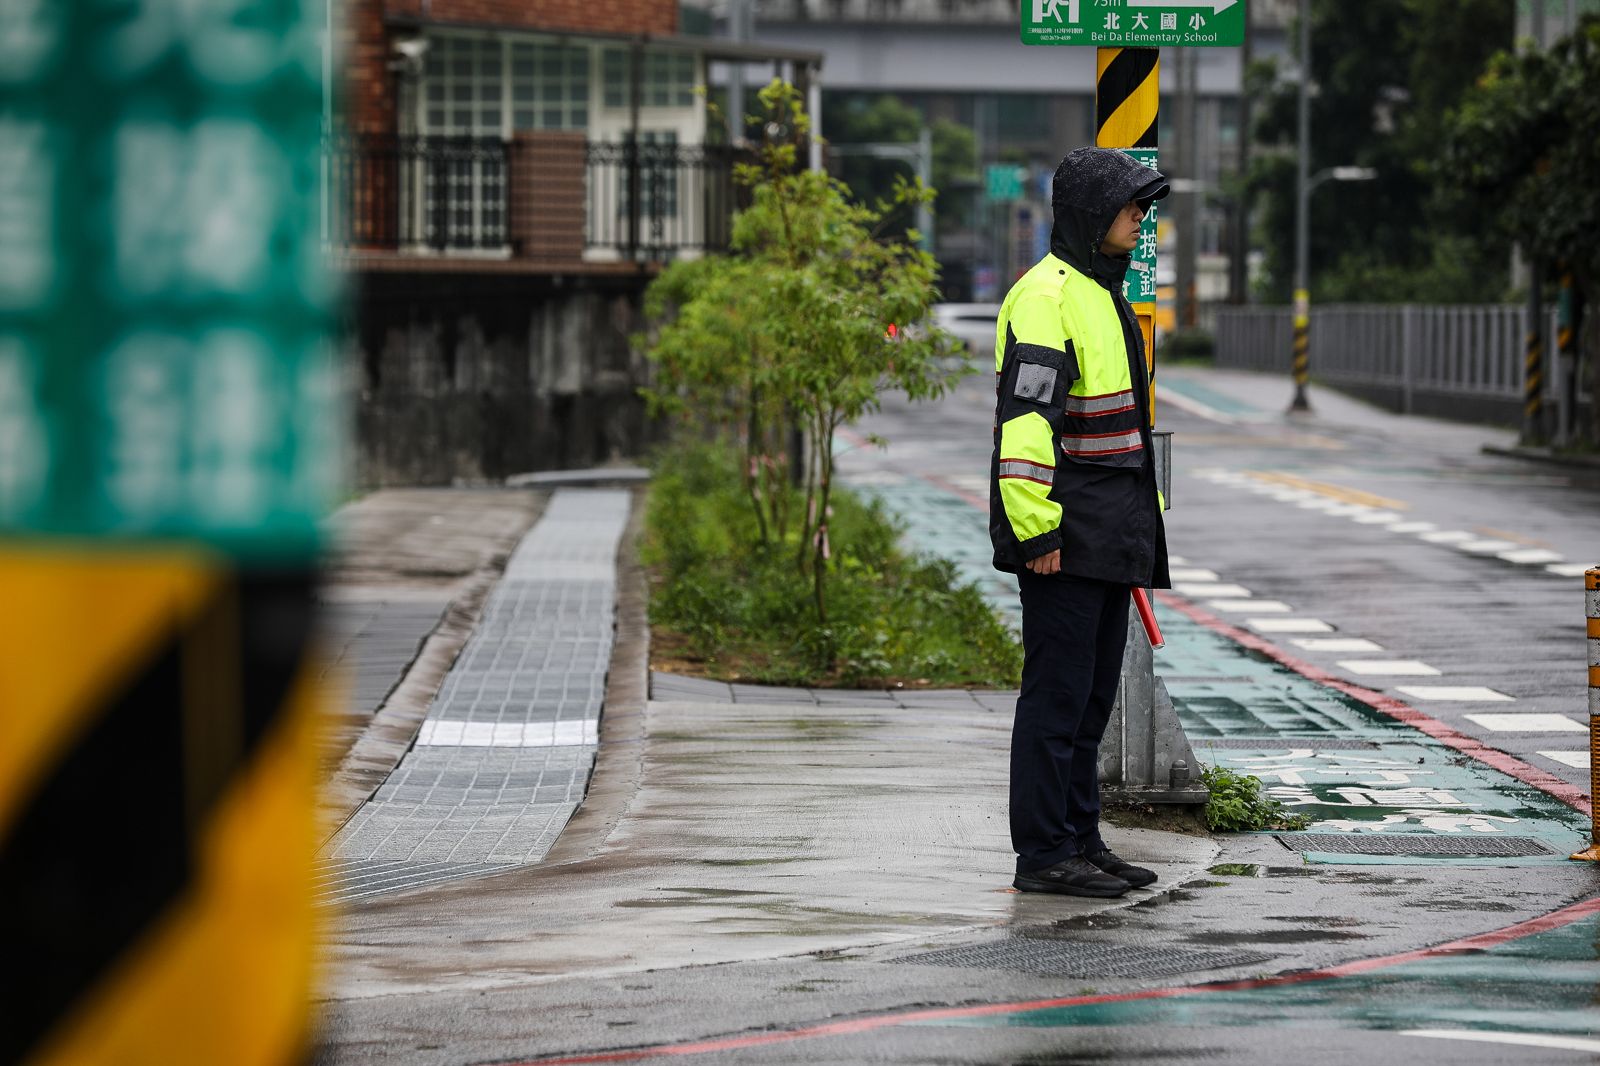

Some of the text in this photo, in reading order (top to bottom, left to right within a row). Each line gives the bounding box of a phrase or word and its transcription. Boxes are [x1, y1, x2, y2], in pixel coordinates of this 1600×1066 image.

[1103, 12, 1206, 31] 北大國小
[1091, 32, 1217, 44] Bei Da Elementary School
[1227, 748, 1483, 807] 人行道
